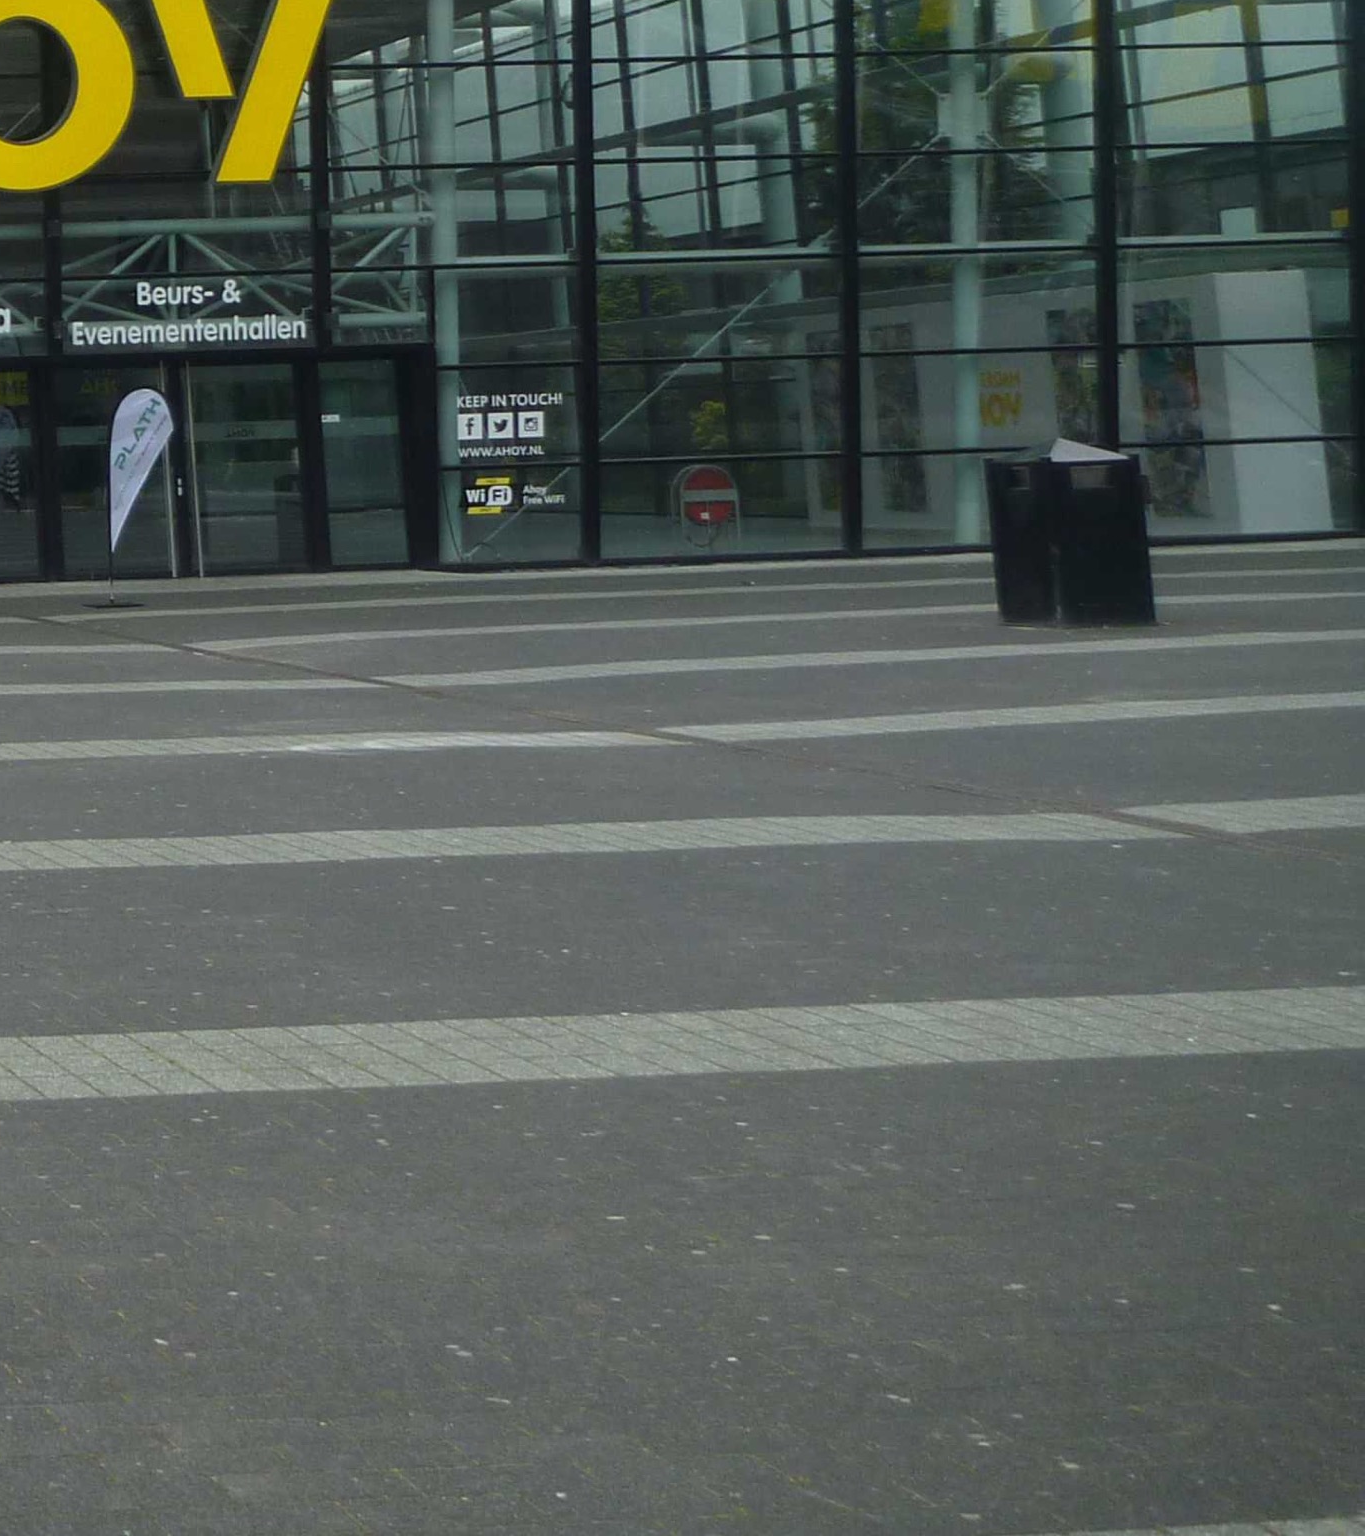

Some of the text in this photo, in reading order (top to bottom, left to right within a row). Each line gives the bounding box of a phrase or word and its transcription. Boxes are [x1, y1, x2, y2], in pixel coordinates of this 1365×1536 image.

[136, 279, 241, 306] Beurs- &
[71, 314, 307, 346] Evenementenhallen
[456, 393, 562, 408] KEEP IN TOUCH!
[114, 398, 162, 470] PLATH
[458, 446, 545, 458] WWW.AHOY.NL
[523, 484, 547, 495] Ahoy
[523, 495, 543, 505] Free
